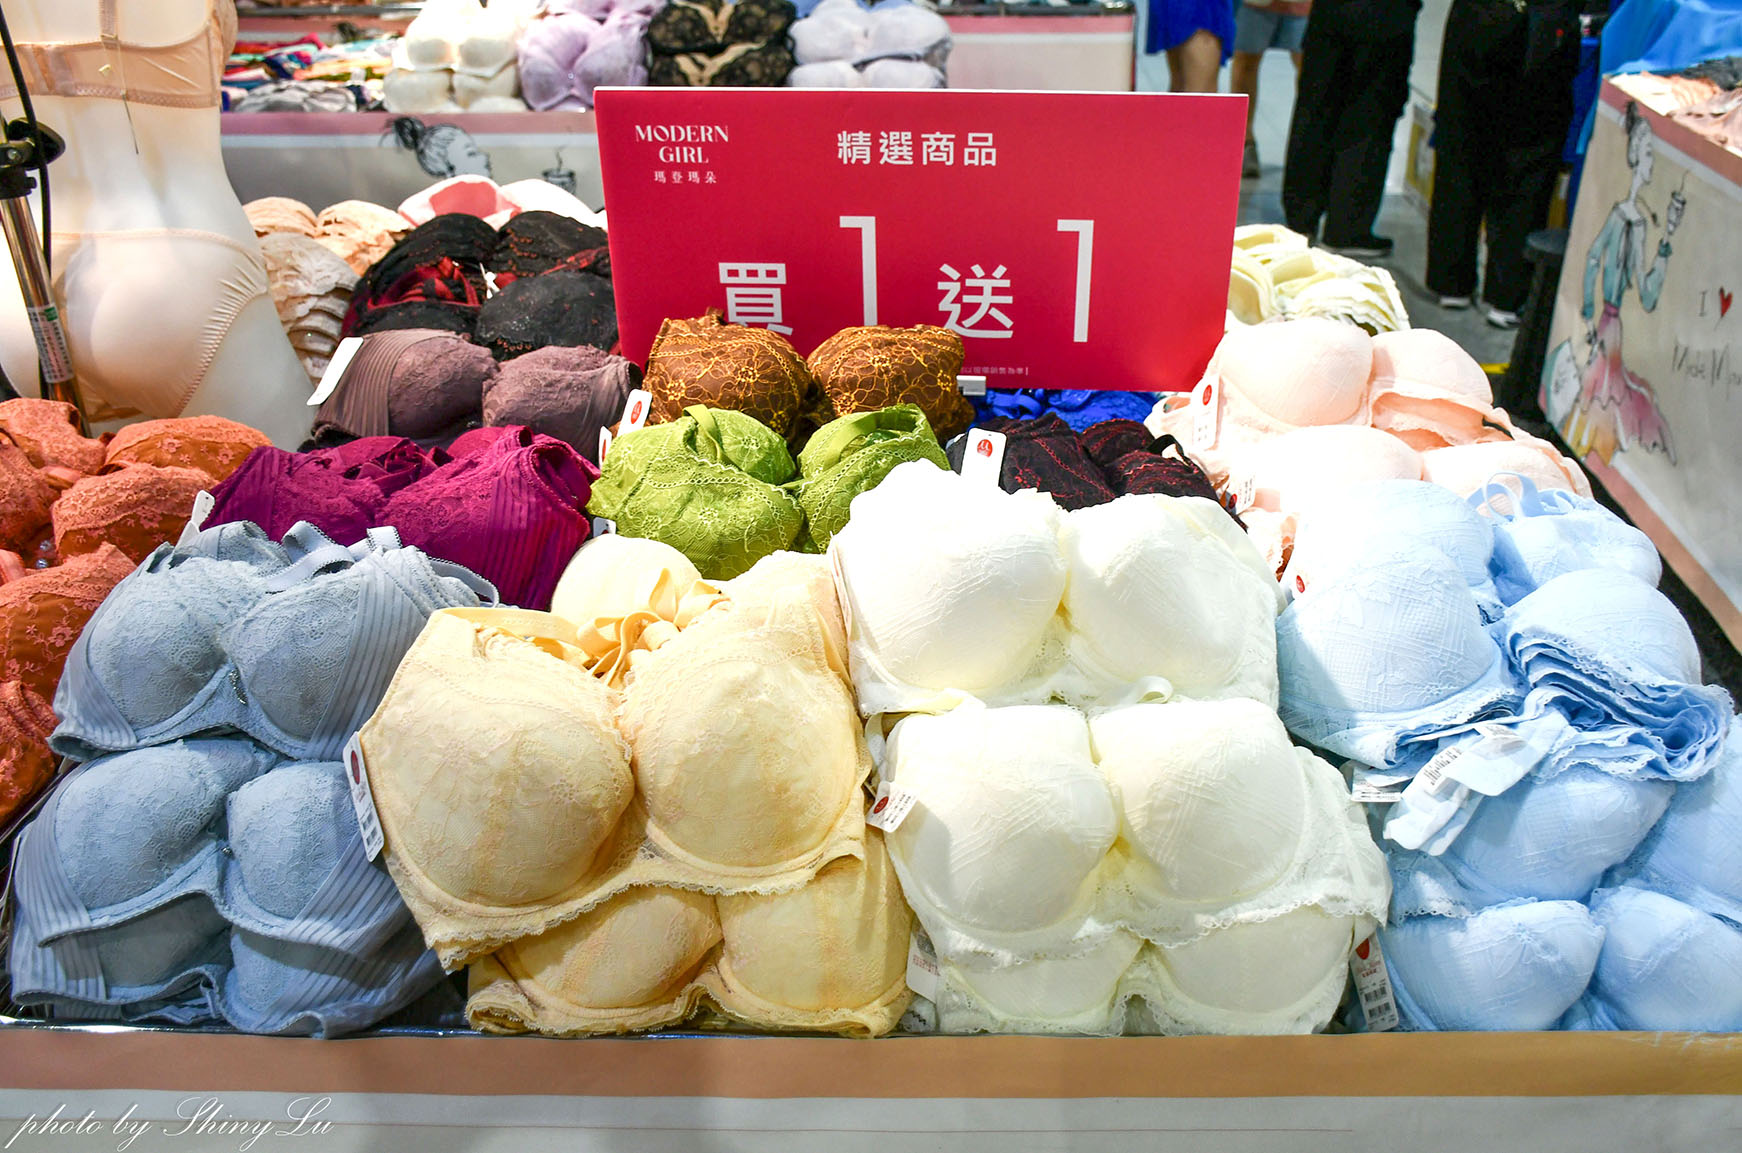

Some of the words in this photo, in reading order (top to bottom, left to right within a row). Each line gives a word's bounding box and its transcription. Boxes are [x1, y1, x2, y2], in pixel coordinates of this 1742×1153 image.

[635, 125, 729, 142] MODERN
[659, 146, 709, 163] GIRL
[837, 131, 997, 166] 精選商品
[654, 171, 717, 184] 瑪登瑪朵
